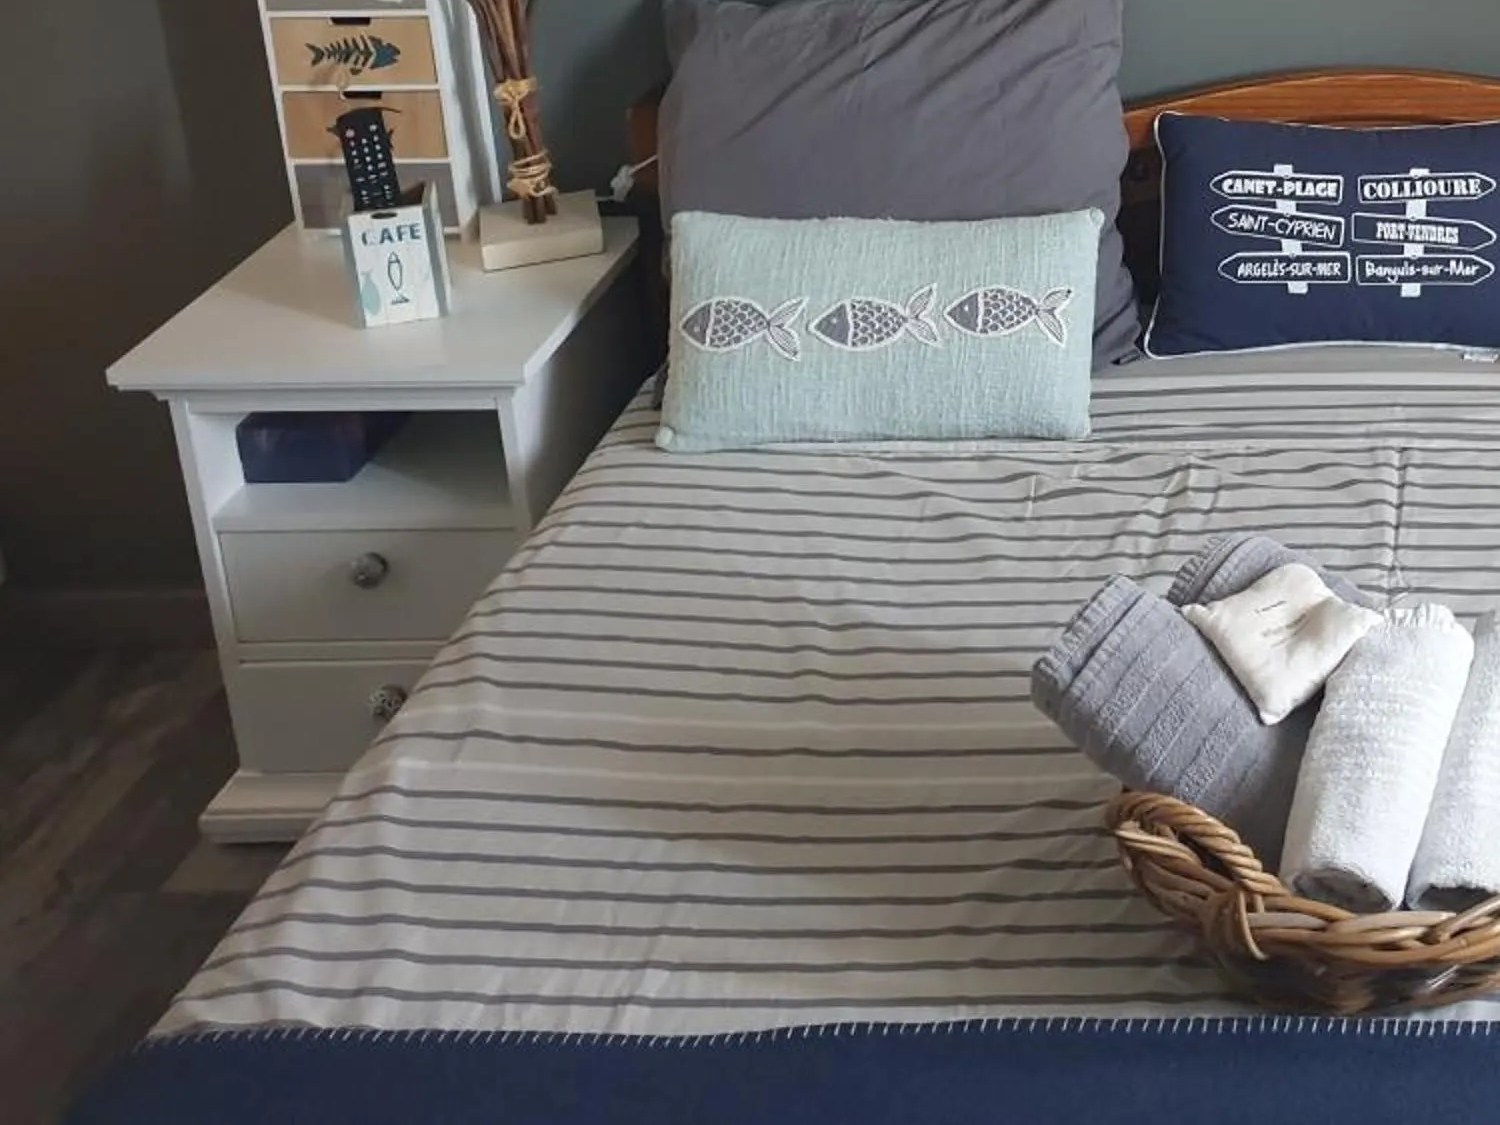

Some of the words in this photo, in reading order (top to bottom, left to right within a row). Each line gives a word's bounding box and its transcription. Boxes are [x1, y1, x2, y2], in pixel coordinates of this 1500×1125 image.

[1222, 178, 1338, 197] CANET-PLAGE
[1363, 178, 1481, 200] COLLIOURE
[361, 222, 421, 246] CAFE
[1227, 212, 1336, 240] SAINT-CYPRIEN
[1376, 221, 1459, 244] PORT-VENDRES
[1365, 259, 1480, 284] Banyuls-sur-Mer
